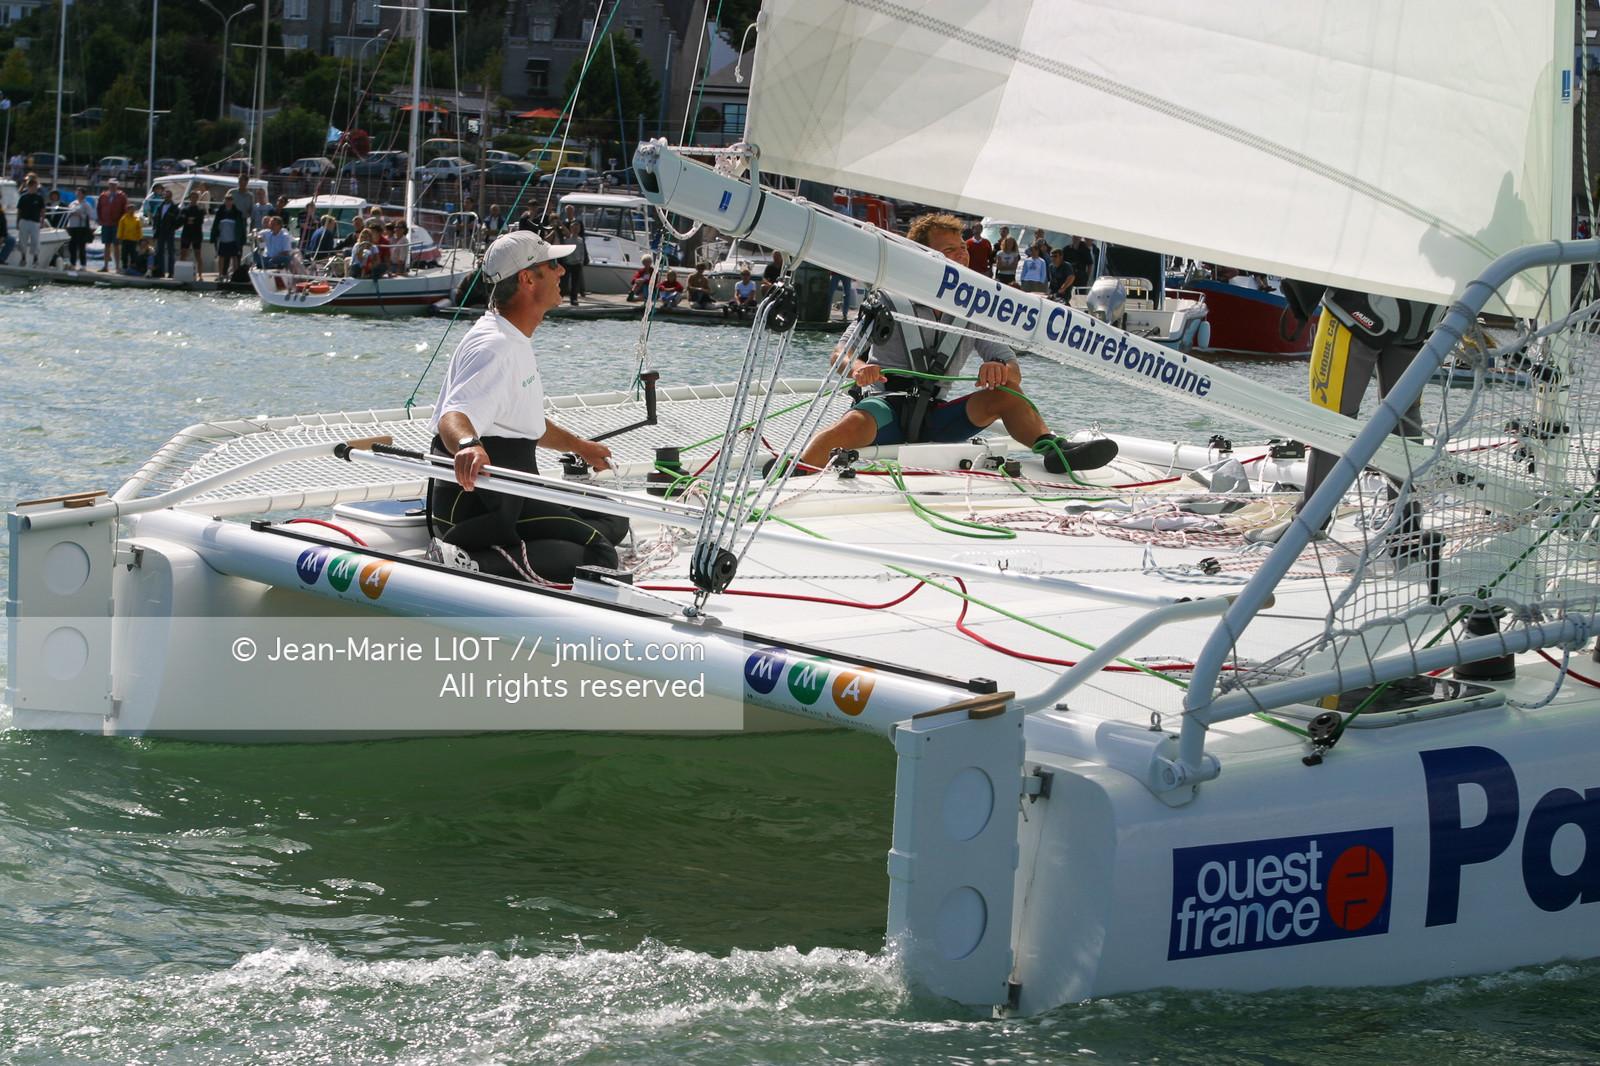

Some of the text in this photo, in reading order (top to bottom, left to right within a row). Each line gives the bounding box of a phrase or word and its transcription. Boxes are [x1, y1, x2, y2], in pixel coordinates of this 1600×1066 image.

[936, 264, 1040, 331] Papiers
[1320, 340, 1332, 377] HOBIE
[1418, 745, 1600, 928] Pa
[1197, 840, 1323, 904] ouest
[1176, 895, 1321, 952] france
